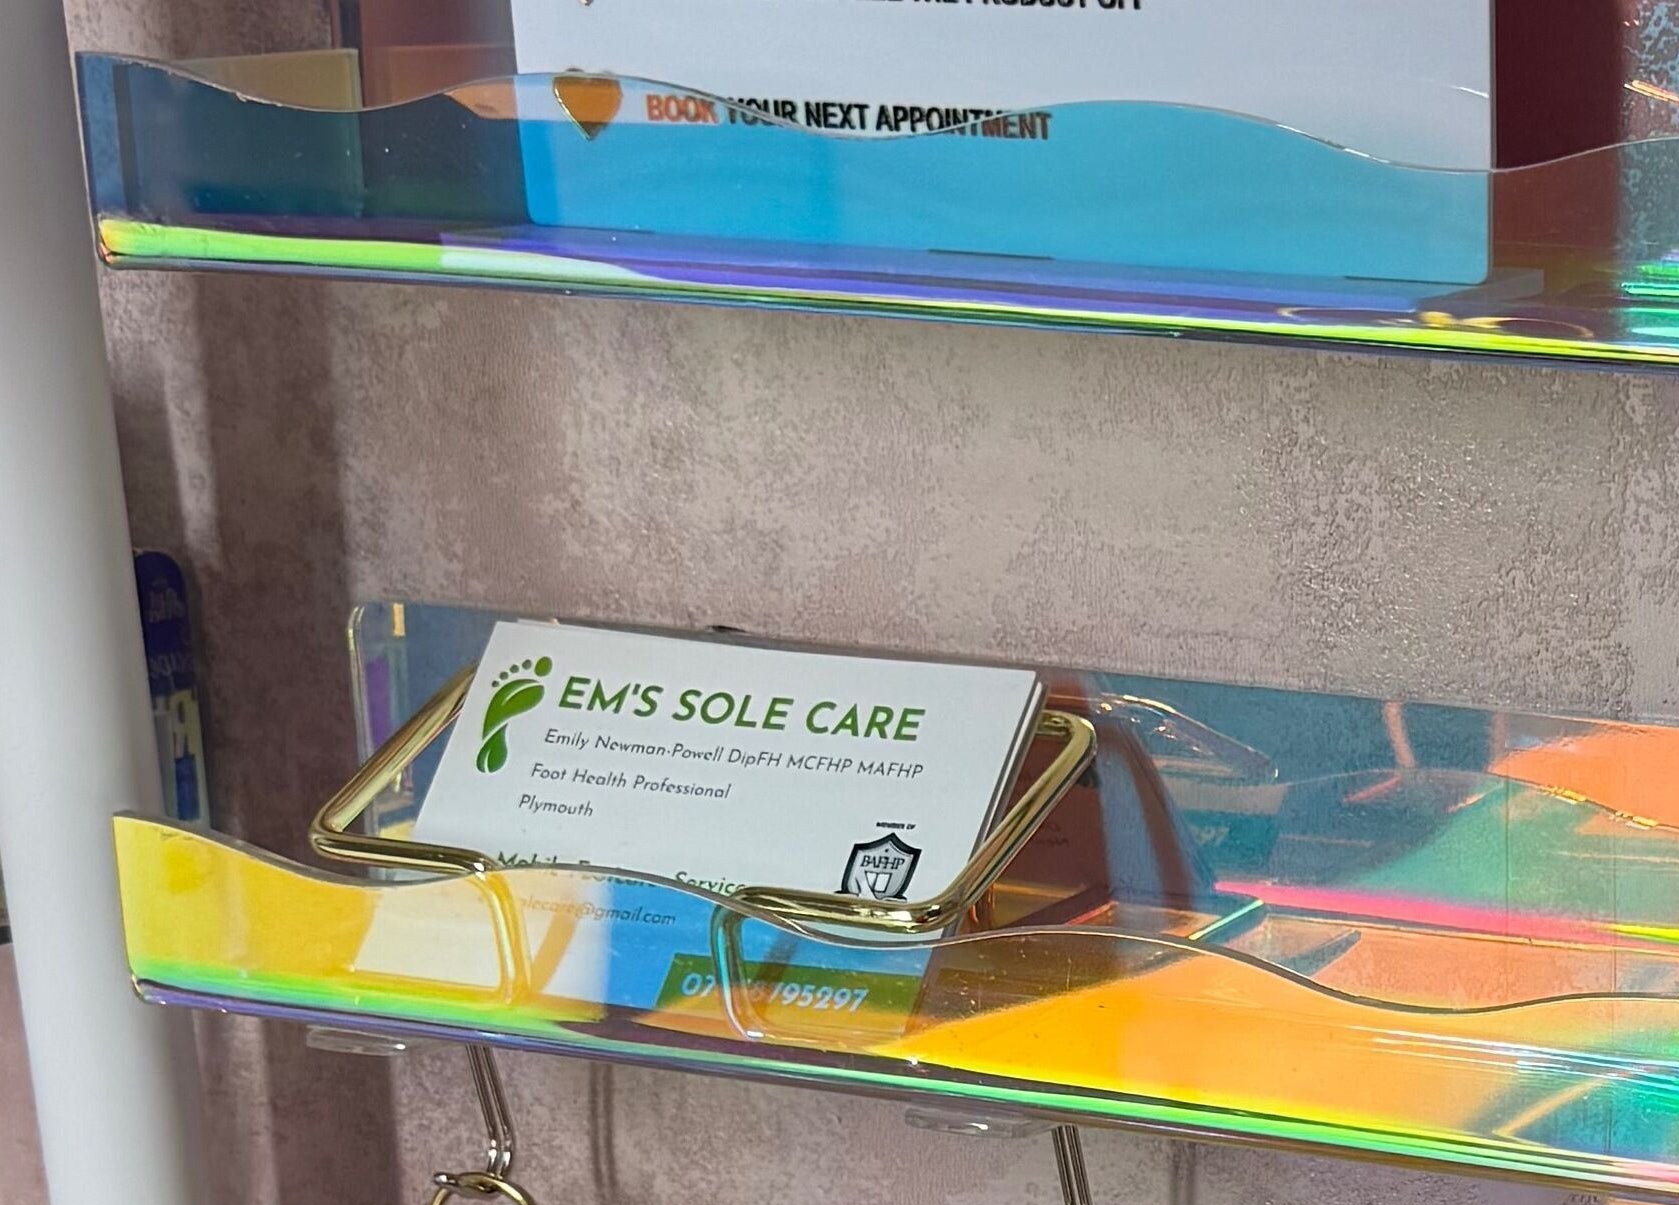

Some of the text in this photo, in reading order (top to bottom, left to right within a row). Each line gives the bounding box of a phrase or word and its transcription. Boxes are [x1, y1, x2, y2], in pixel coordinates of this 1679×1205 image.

[645, 94, 1053, 140] BOOK YOUR NEXT APPOINTMENT
[558, 675, 926, 741] EM'S SOLE CARE
[544, 729, 589, 751] Emily
[728, 749, 781, 768] DipFH
[787, 755, 852, 774] MCFHP
[857, 760, 924, 780] MAFHP
[531, 763, 732, 799] Foot Health Professional
[518, 795, 594, 817] Plymouth
[675, 871, 746, 897] Servic
